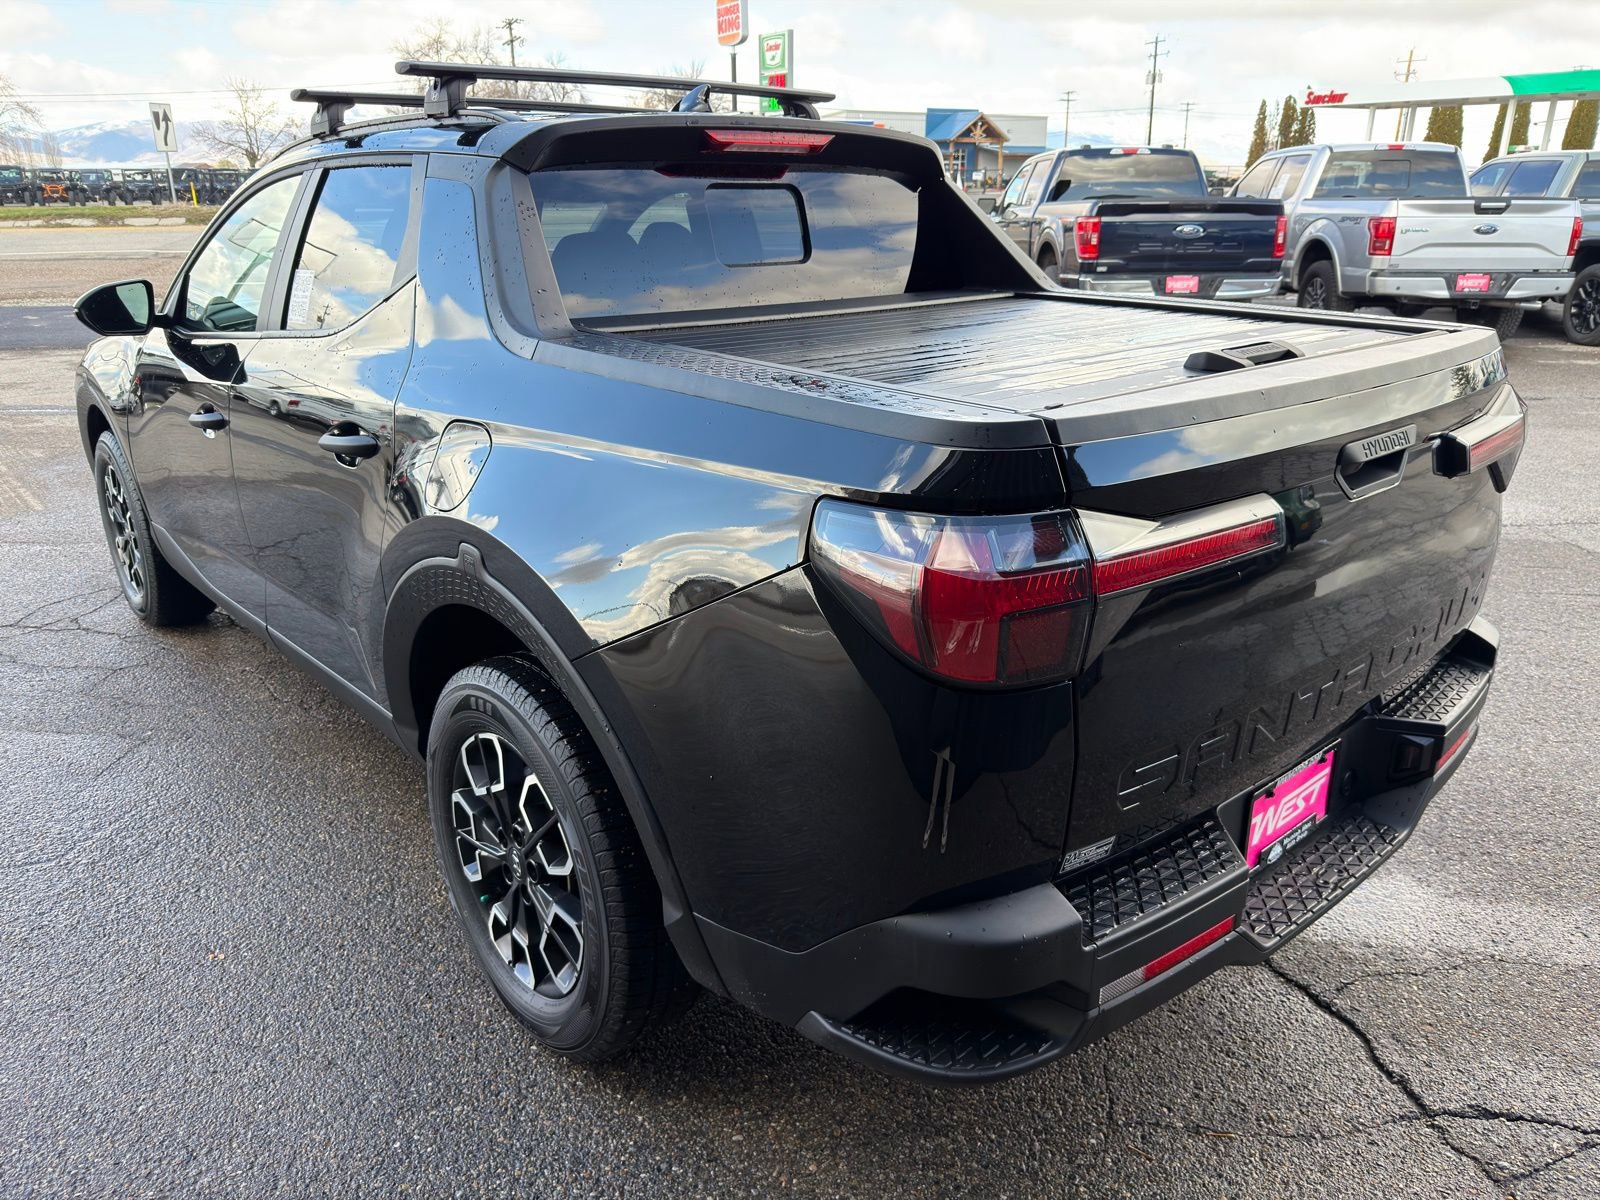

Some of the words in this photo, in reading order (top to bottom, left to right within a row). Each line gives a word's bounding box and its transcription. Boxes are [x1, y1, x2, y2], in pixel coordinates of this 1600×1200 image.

[717, 3, 740, 18] BURGER
[717, 13, 741, 35] KING
[1304, 89, 1349, 105] Sinclair
[1361, 429, 1411, 459] HYUNDAI
[1251, 766, 1332, 846] WEST
